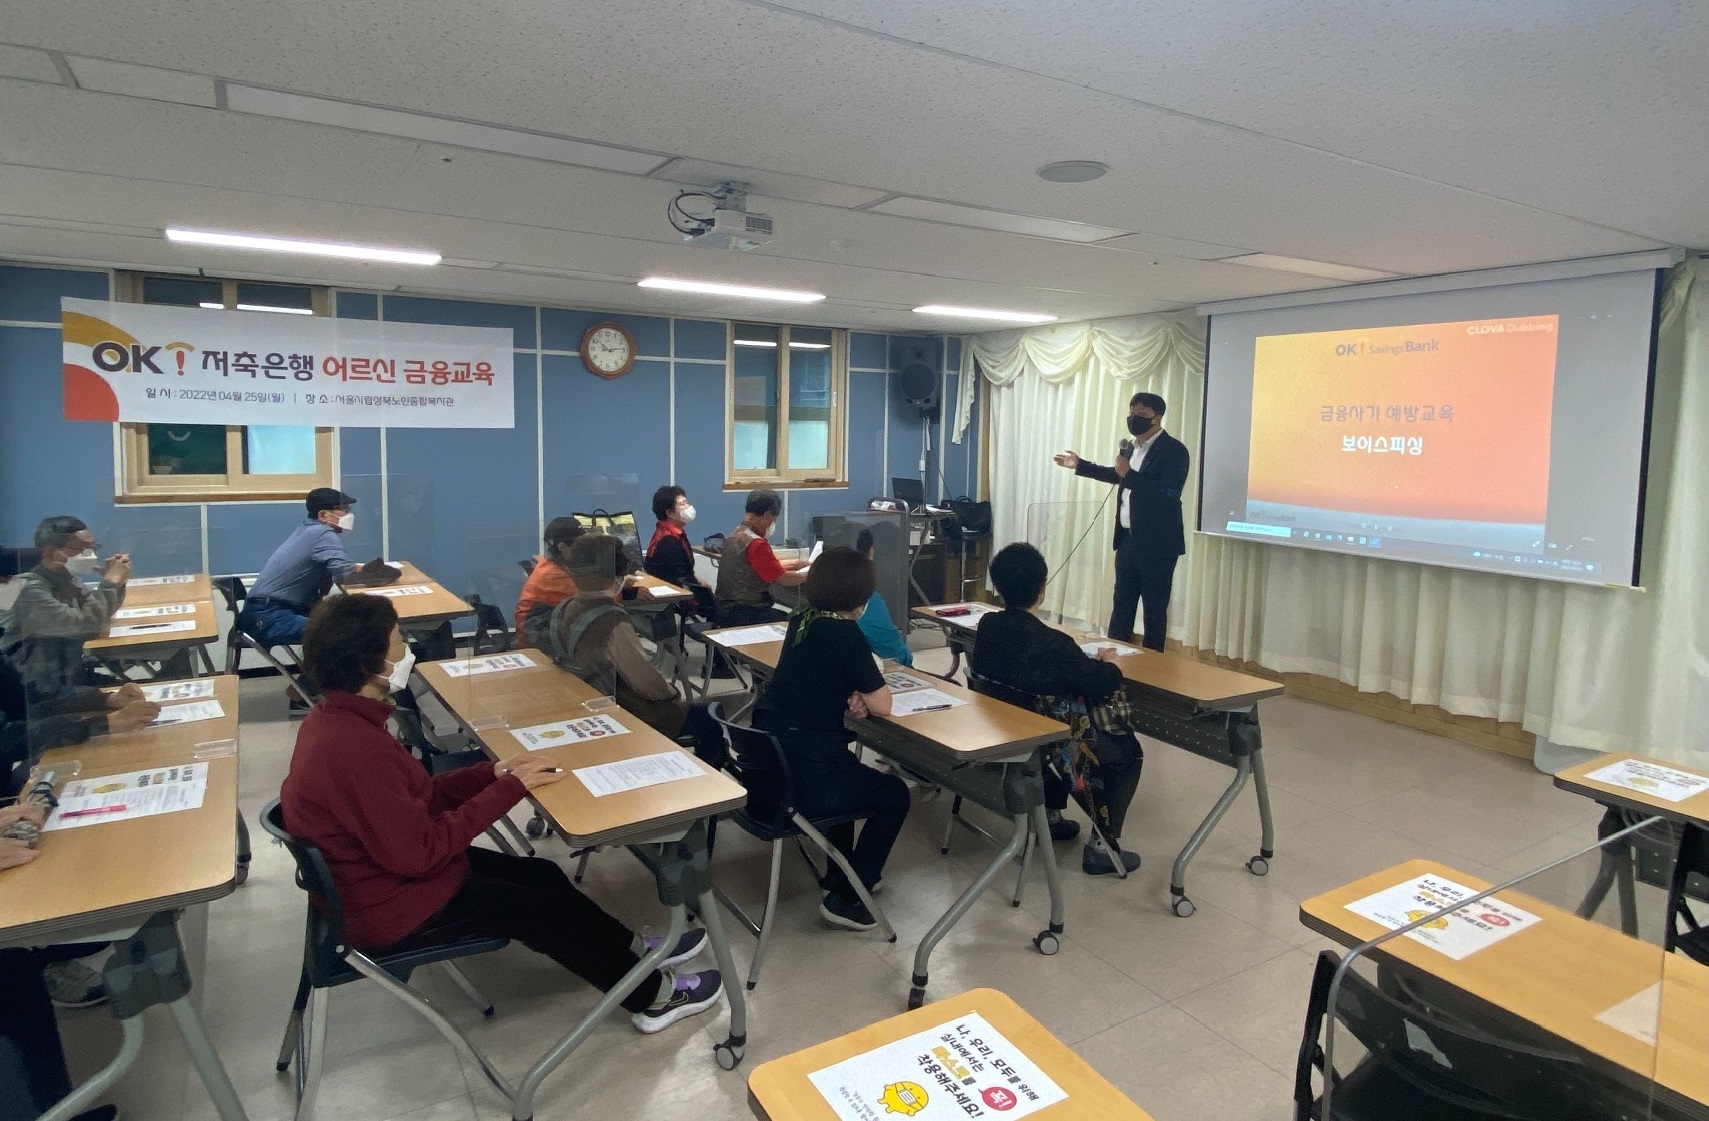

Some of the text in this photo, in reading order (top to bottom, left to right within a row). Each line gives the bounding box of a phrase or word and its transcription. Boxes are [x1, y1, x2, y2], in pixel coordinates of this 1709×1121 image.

[1467, 322, 1553, 336] CLOVA Dubbing
[202, 350, 314, 381] 저축은행
[322, 356, 396, 384] 어르신
[403, 360, 495, 387] 금융교육
[1320, 404, 1455, 422] 금융사기 예방교육
[1341, 435, 1424, 456] 보이스피싱
[940, 1032, 985, 1073] 실내에서는
[969, 1037, 994, 1060] 우리,
[989, 1058, 1022, 1085] 모두를
[1017, 1082, 1040, 1102] 위해
[917, 1053, 986, 1120] 착용해주세요!
